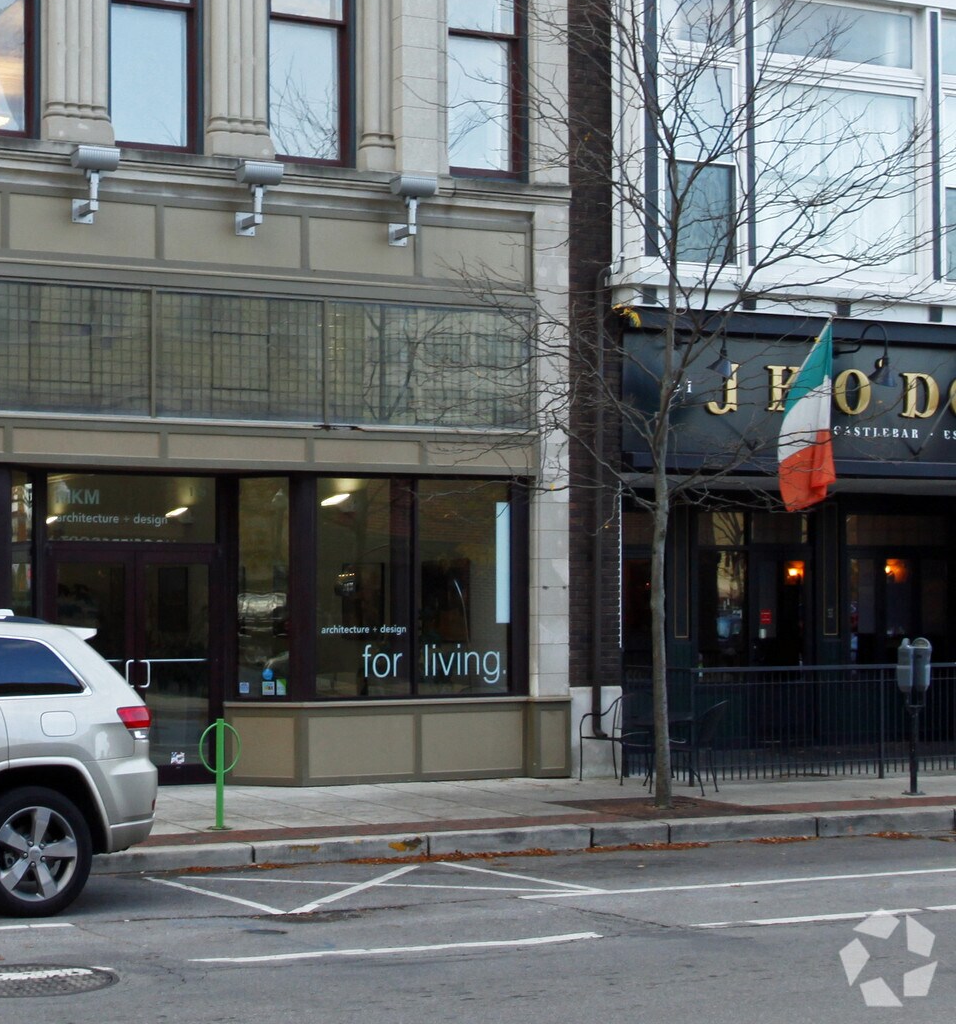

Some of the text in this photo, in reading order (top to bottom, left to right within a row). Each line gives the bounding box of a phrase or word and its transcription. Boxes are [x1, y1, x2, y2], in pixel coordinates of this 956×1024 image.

[706, 363, 740, 415] J
[833, 425, 919, 439] CASTLEBAR
[55, 489, 100, 505] MKM
[56, 512, 119, 524] architecture
[133, 513, 168, 527] design
[320, 624, 370, 634] architecture
[380, 624, 407, 636] design
[362, 643, 507, 684] for living.
